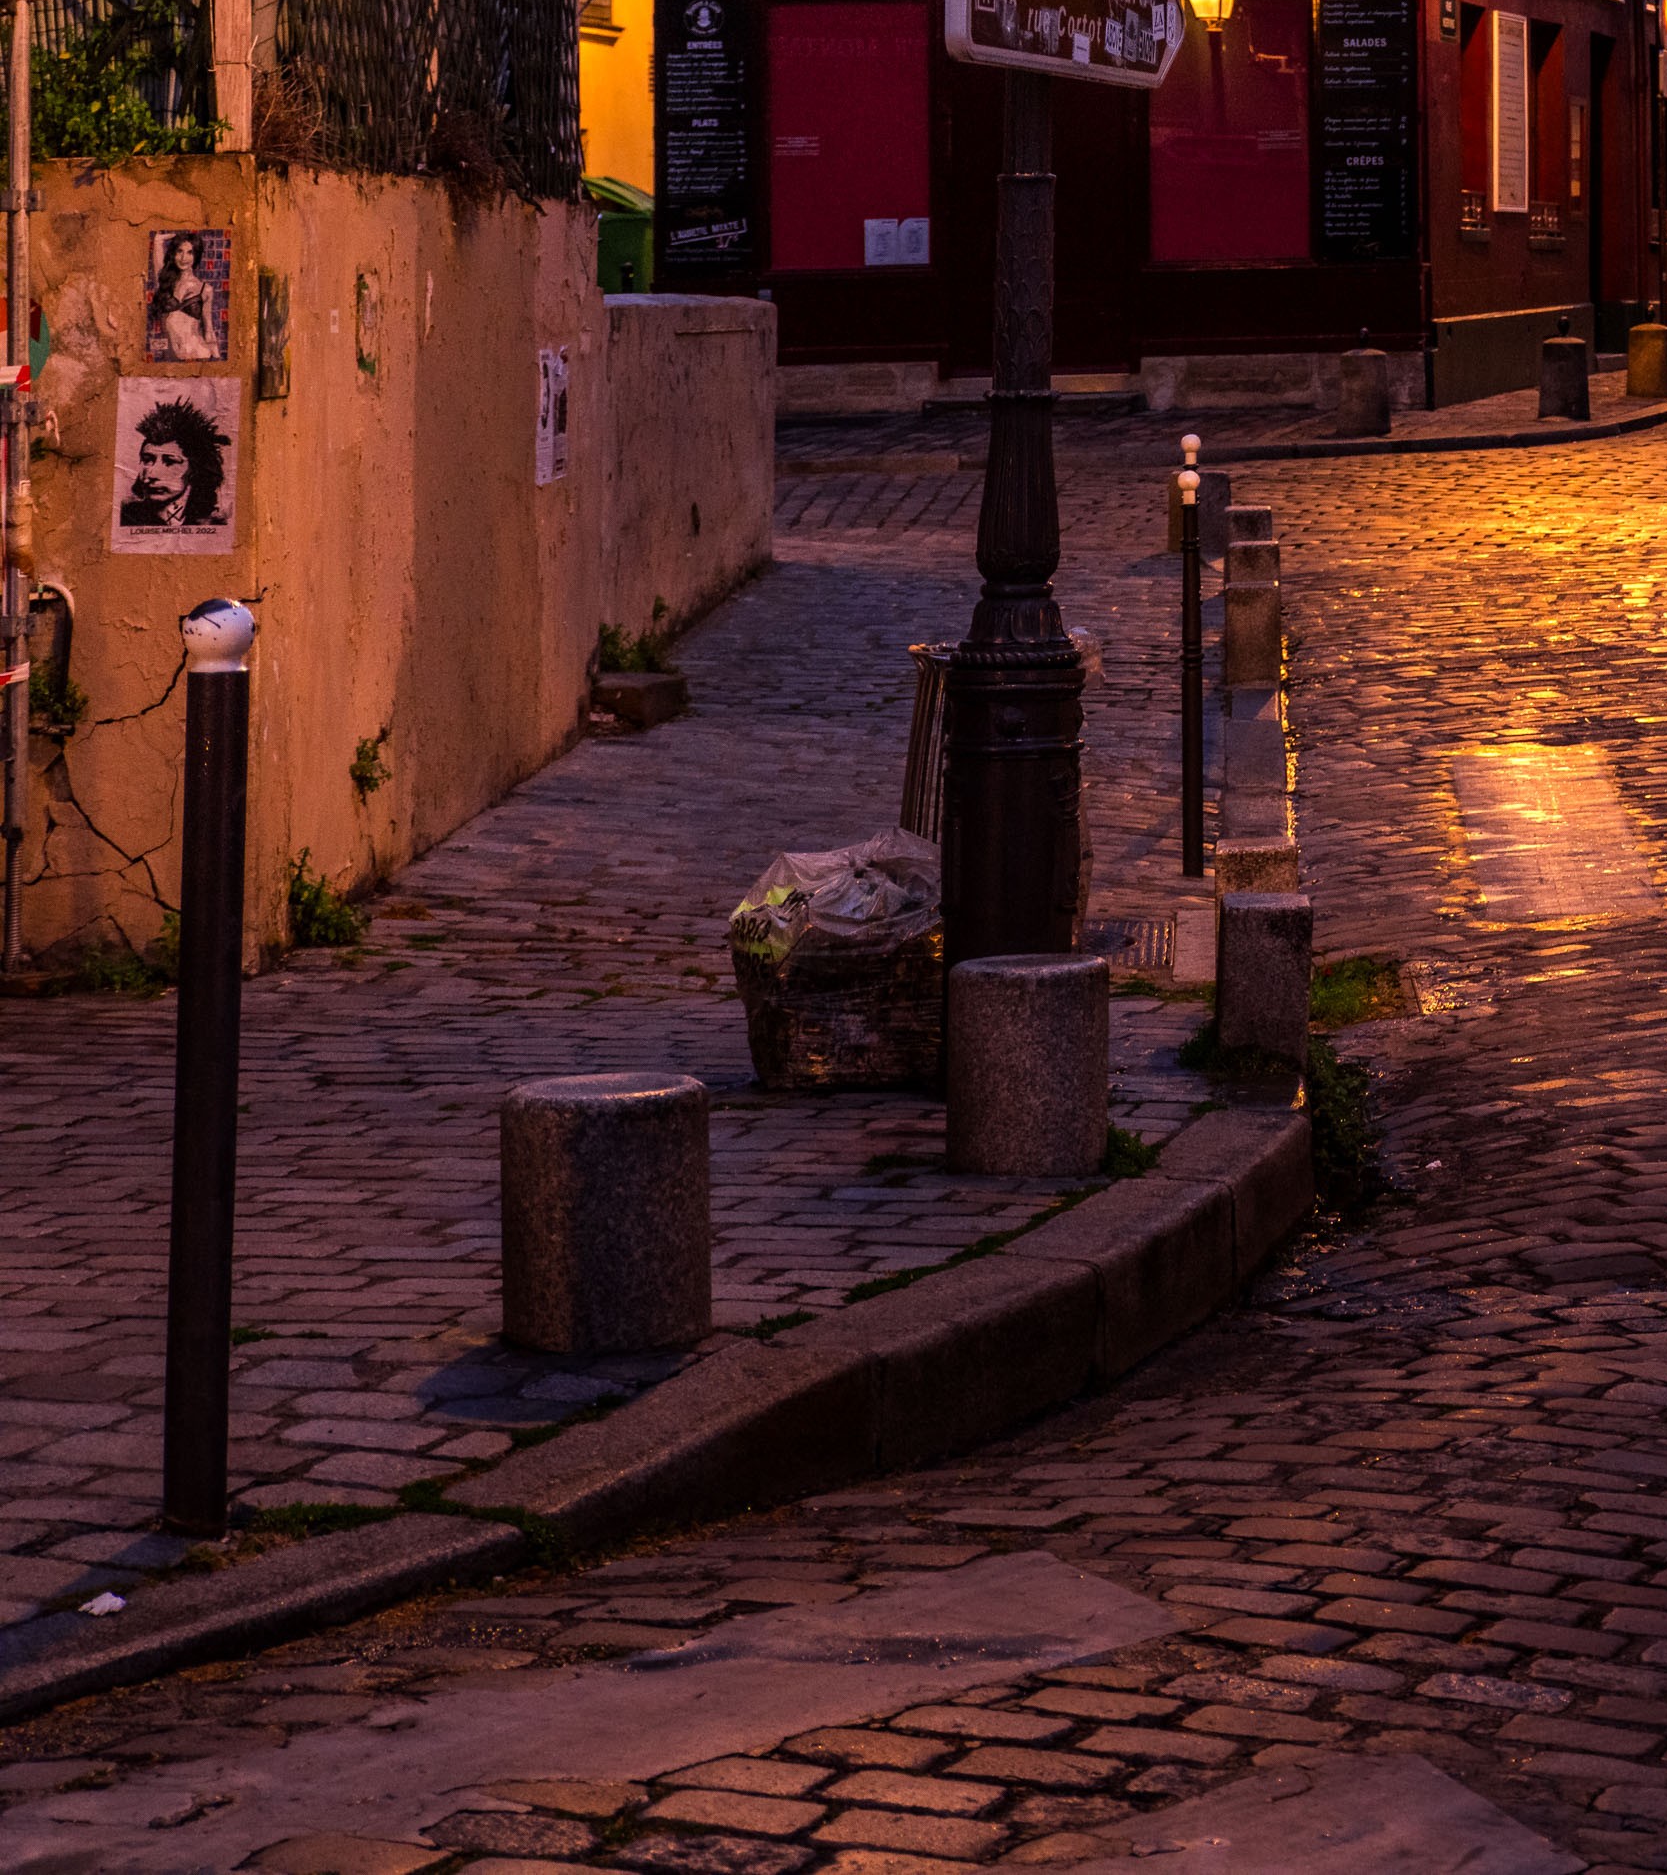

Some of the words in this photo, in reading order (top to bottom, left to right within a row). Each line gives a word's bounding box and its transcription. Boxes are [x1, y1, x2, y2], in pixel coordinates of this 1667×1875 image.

[1028, 6, 1050, 35] rue
[1058, 5, 1101, 42] Cortot
[1343, 37, 1388, 47] SALADES
[1346, 155, 1384, 166] CRÊPES
[196, 527, 217, 535] 2022
